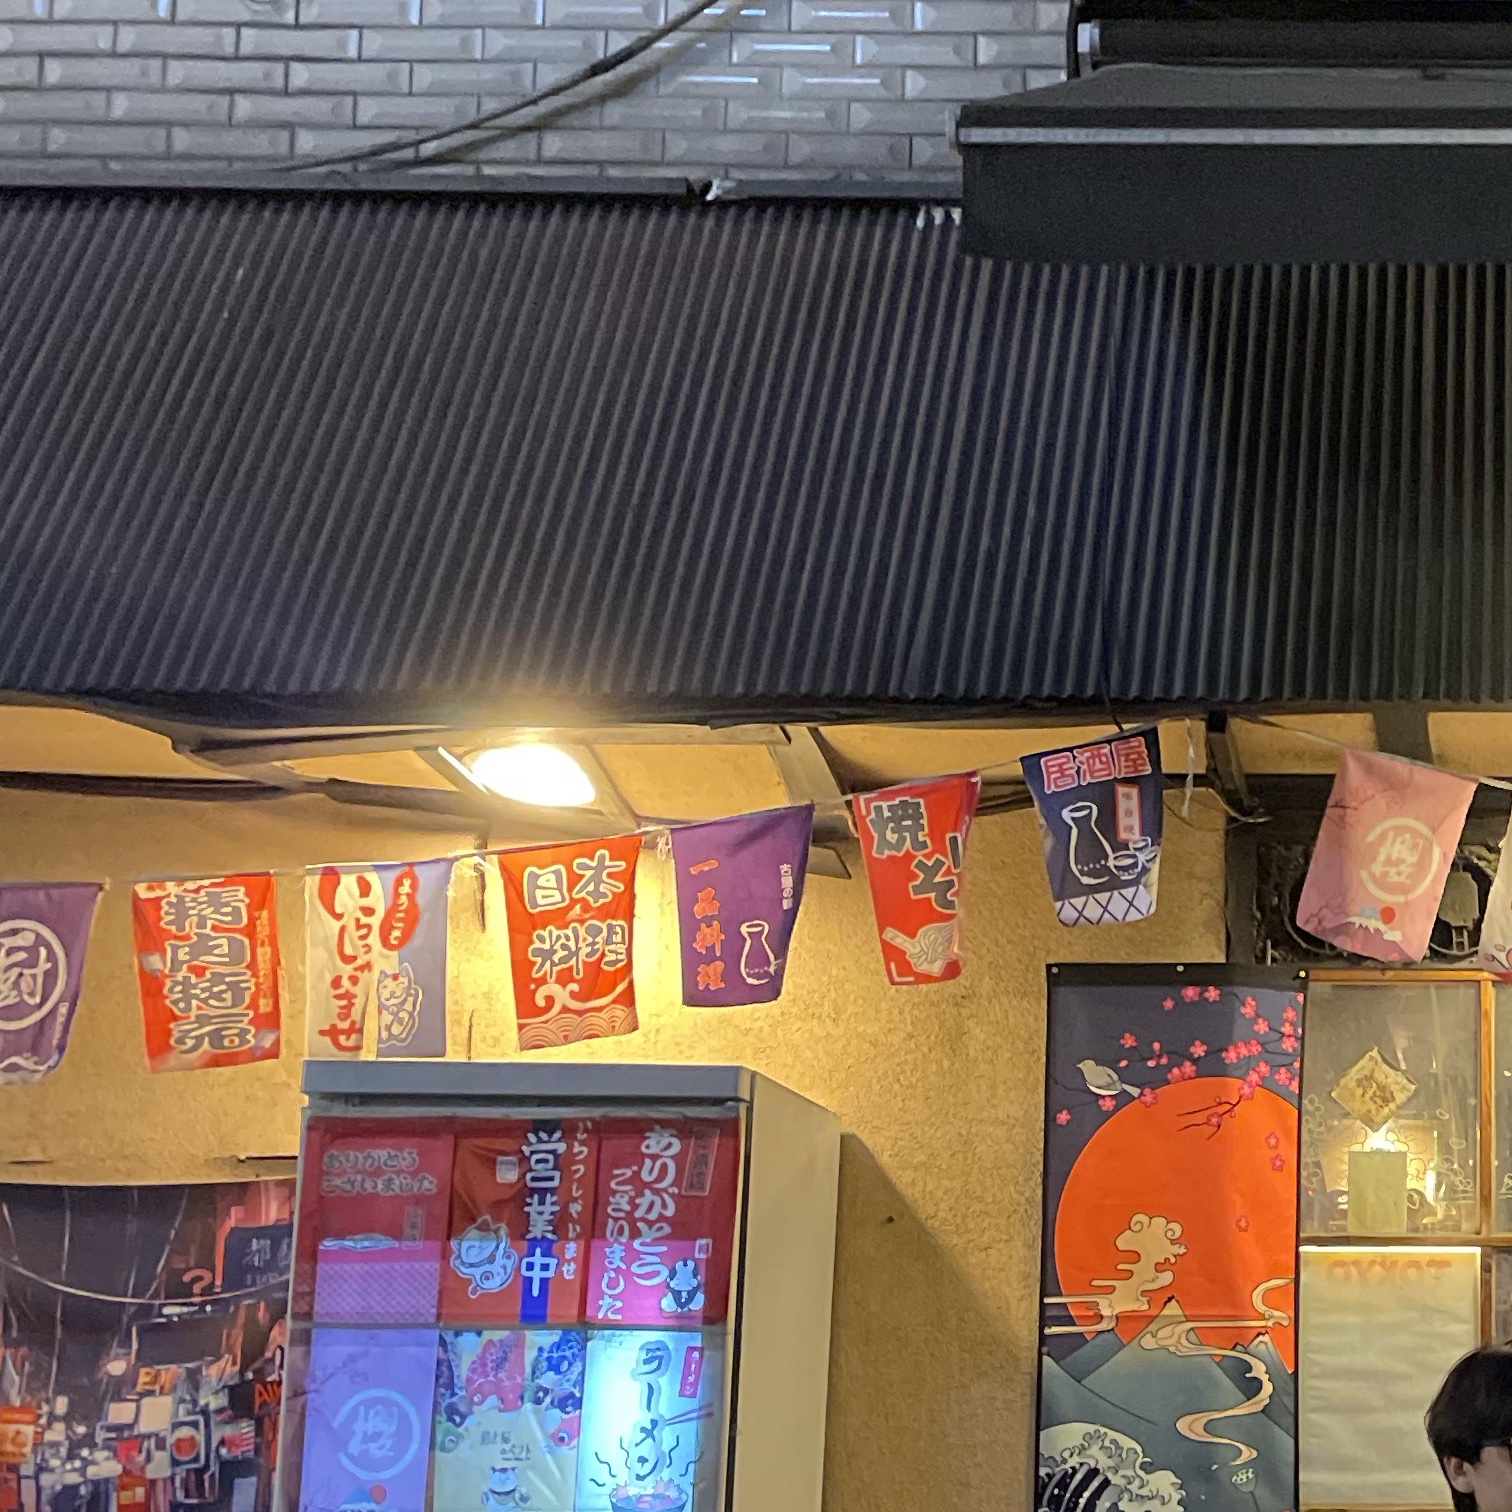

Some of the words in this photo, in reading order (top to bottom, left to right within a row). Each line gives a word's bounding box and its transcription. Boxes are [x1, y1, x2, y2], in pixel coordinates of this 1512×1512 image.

[1041, 736, 1152, 794] 居酒屋
[387, 877, 412, 945] ようこそ
[523, 849, 626, 913] 日本
[689, 858, 726, 991] 一品料理
[318, 865, 374, 1053] いらっしゃいませ
[528, 919, 628, 983] 料理
[320, 1173, 437, 1196] ございました
[323, 1149, 418, 1172] ありがとう
[630, 1125, 682, 1287] ありがとう
[520, 1128, 567, 1298] 営業中
[597, 1165, 640, 1321] ございました
[633, 1345, 665, 1482] ラーメン
